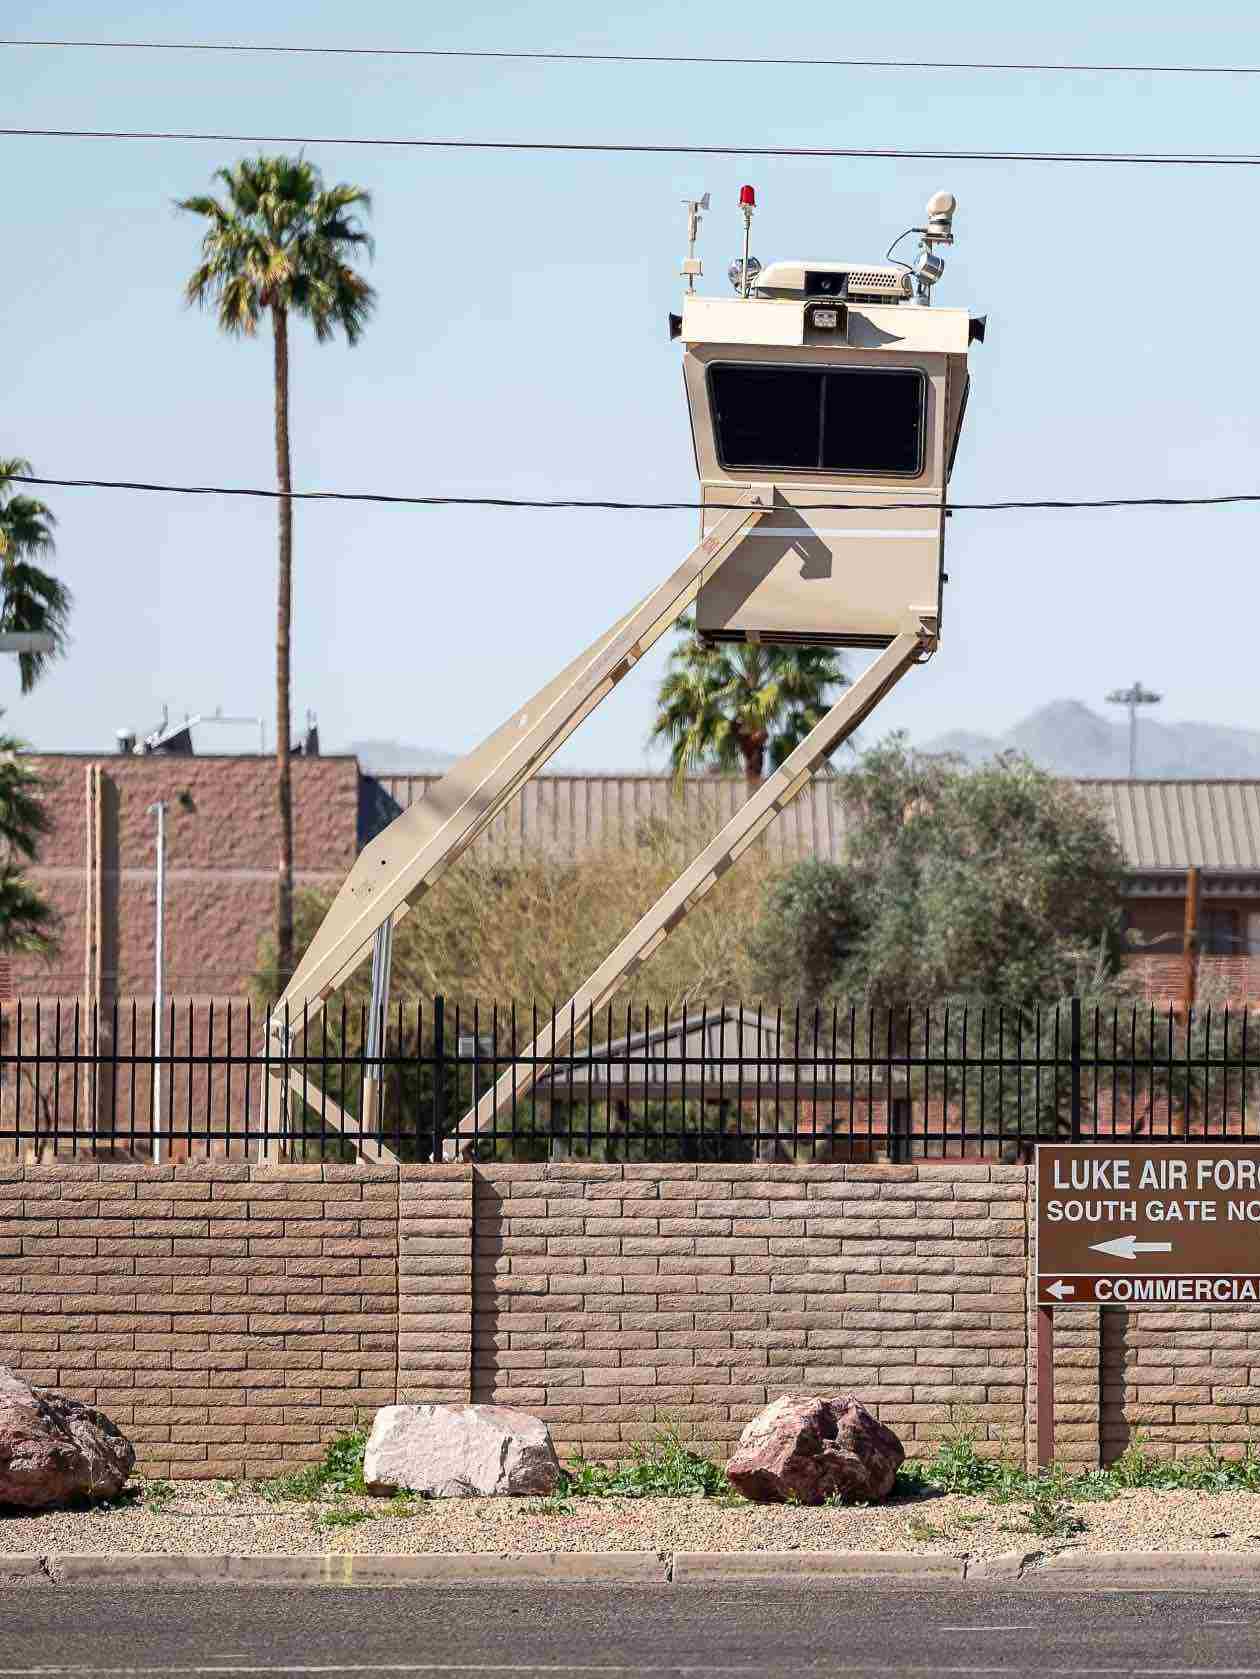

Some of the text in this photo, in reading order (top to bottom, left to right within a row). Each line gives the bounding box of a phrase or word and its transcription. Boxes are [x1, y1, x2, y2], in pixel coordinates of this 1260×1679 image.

[1054, 1159, 1130, 1190] LUKE
[1138, 1159, 1188, 1190] AIR
[1046, 1200, 1217, 1222] SOUTH GATE
